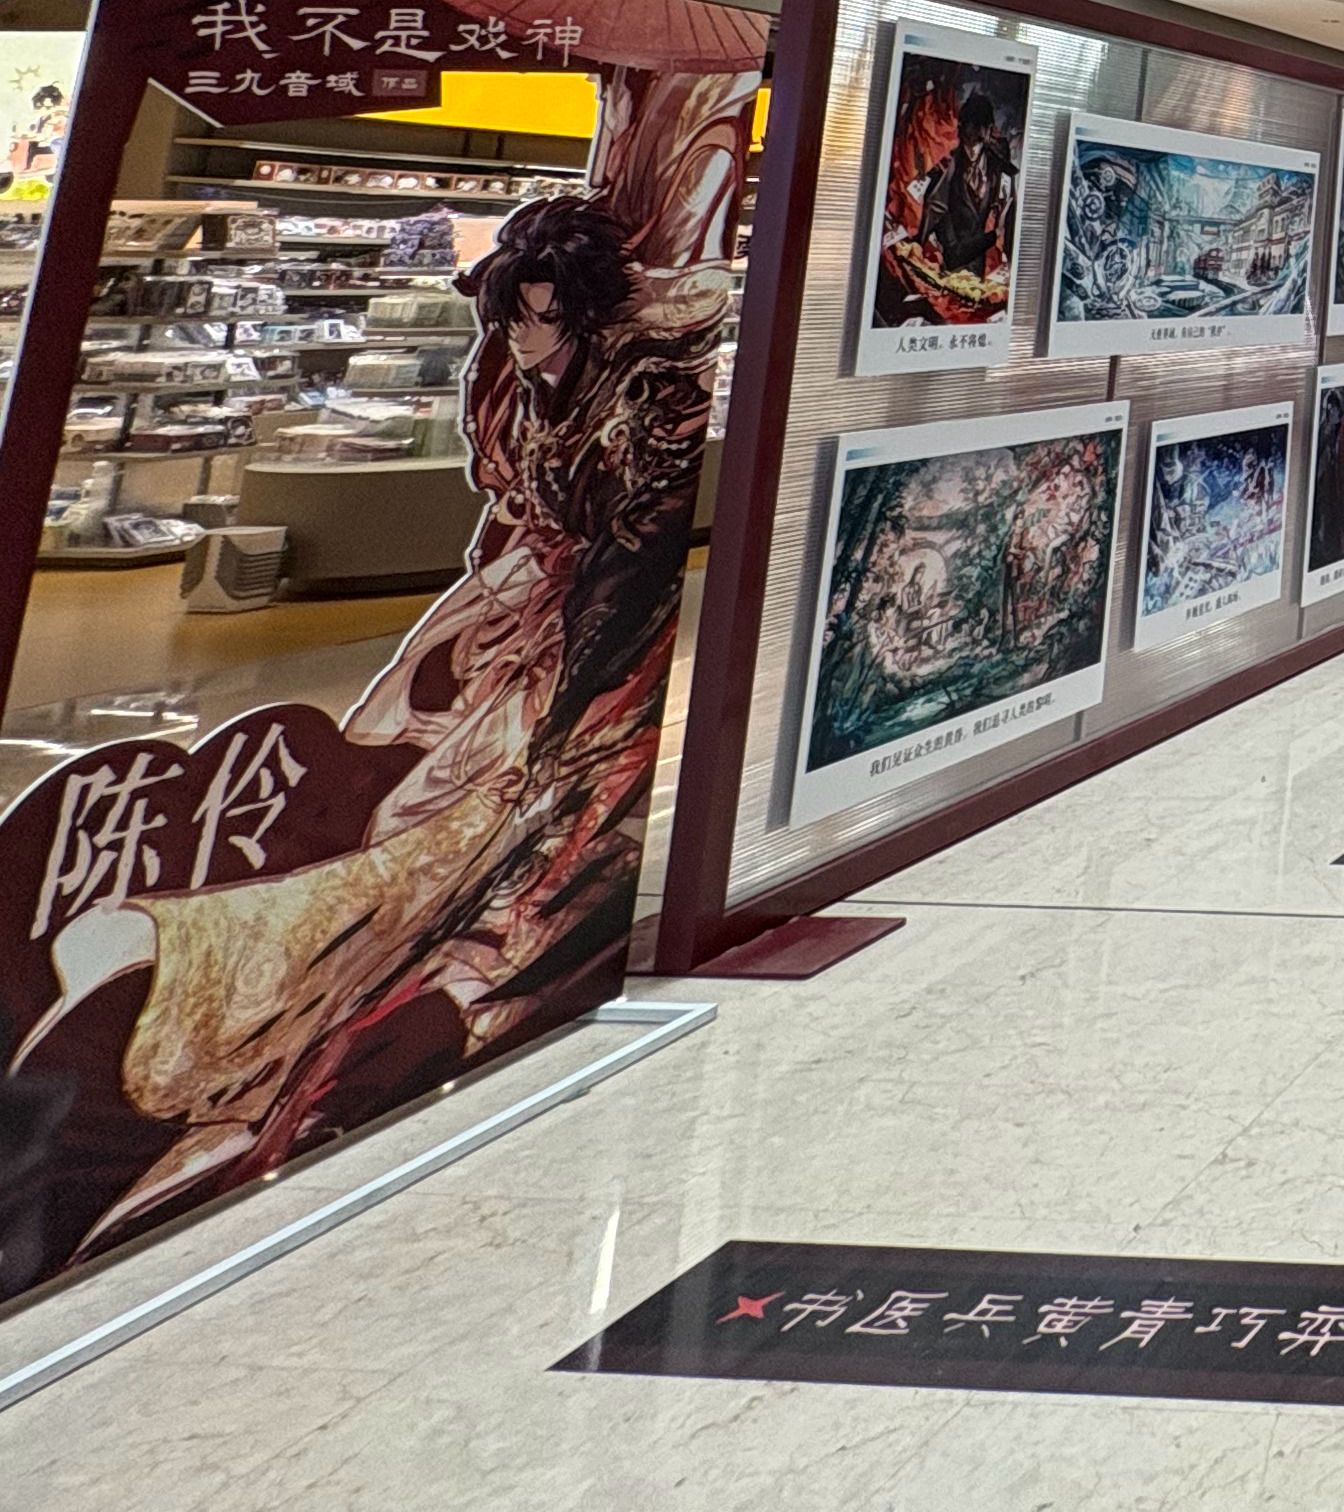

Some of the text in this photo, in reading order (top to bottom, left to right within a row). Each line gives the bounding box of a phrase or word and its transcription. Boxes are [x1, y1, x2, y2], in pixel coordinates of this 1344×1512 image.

[184, 69, 367, 98] 三九音域
[31, 723, 307, 940] 陈伶
